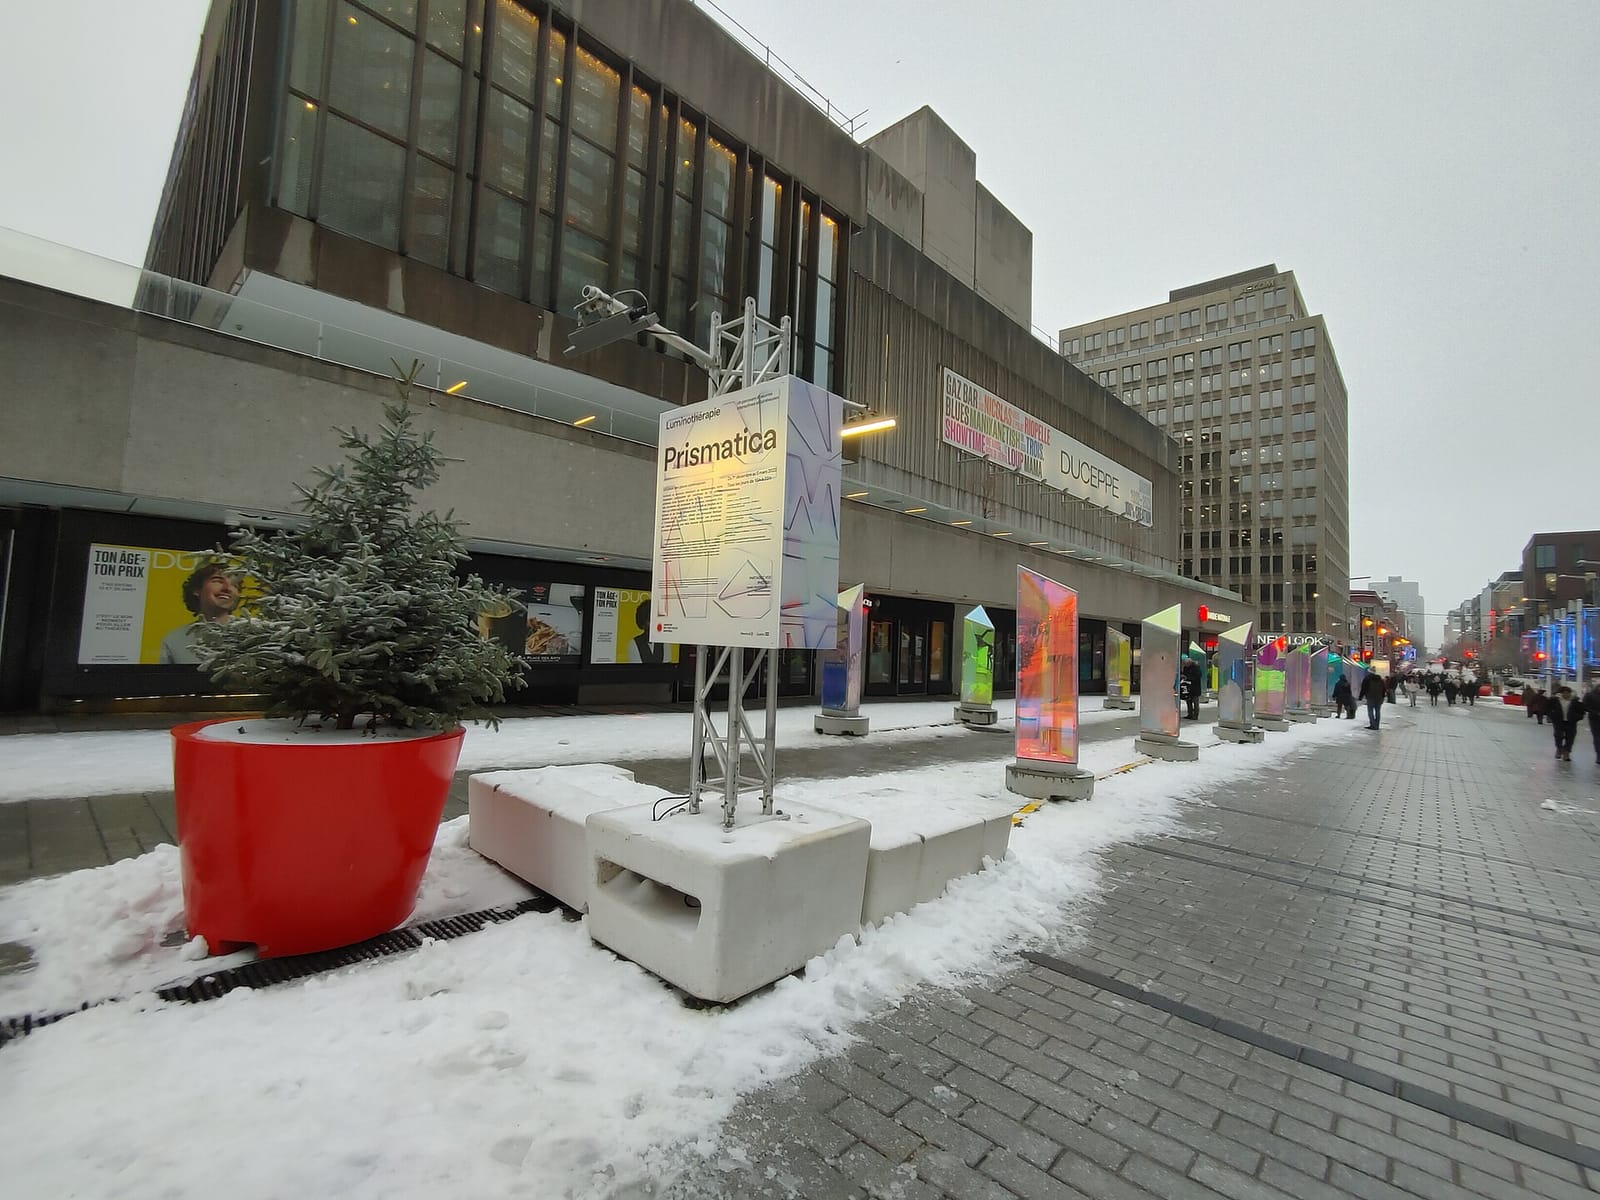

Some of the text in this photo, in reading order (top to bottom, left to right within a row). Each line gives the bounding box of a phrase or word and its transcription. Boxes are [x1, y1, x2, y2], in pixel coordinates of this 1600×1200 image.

[946, 374, 978, 409] GAZ BAR
[665, 407, 721, 430] Luminothérapie
[945, 395, 970, 426] BLUES
[944, 418, 986, 454] SHOWTIME
[1024, 416, 1051, 446] RIOPELLE
[663, 426, 777, 472] Prismatica
[1007, 446, 1024, 468] LOUP
[1060, 449, 1120, 499] DUCEPPE
[94, 563, 144, 578] TON PRIX
[95, 550, 118, 563] TON
